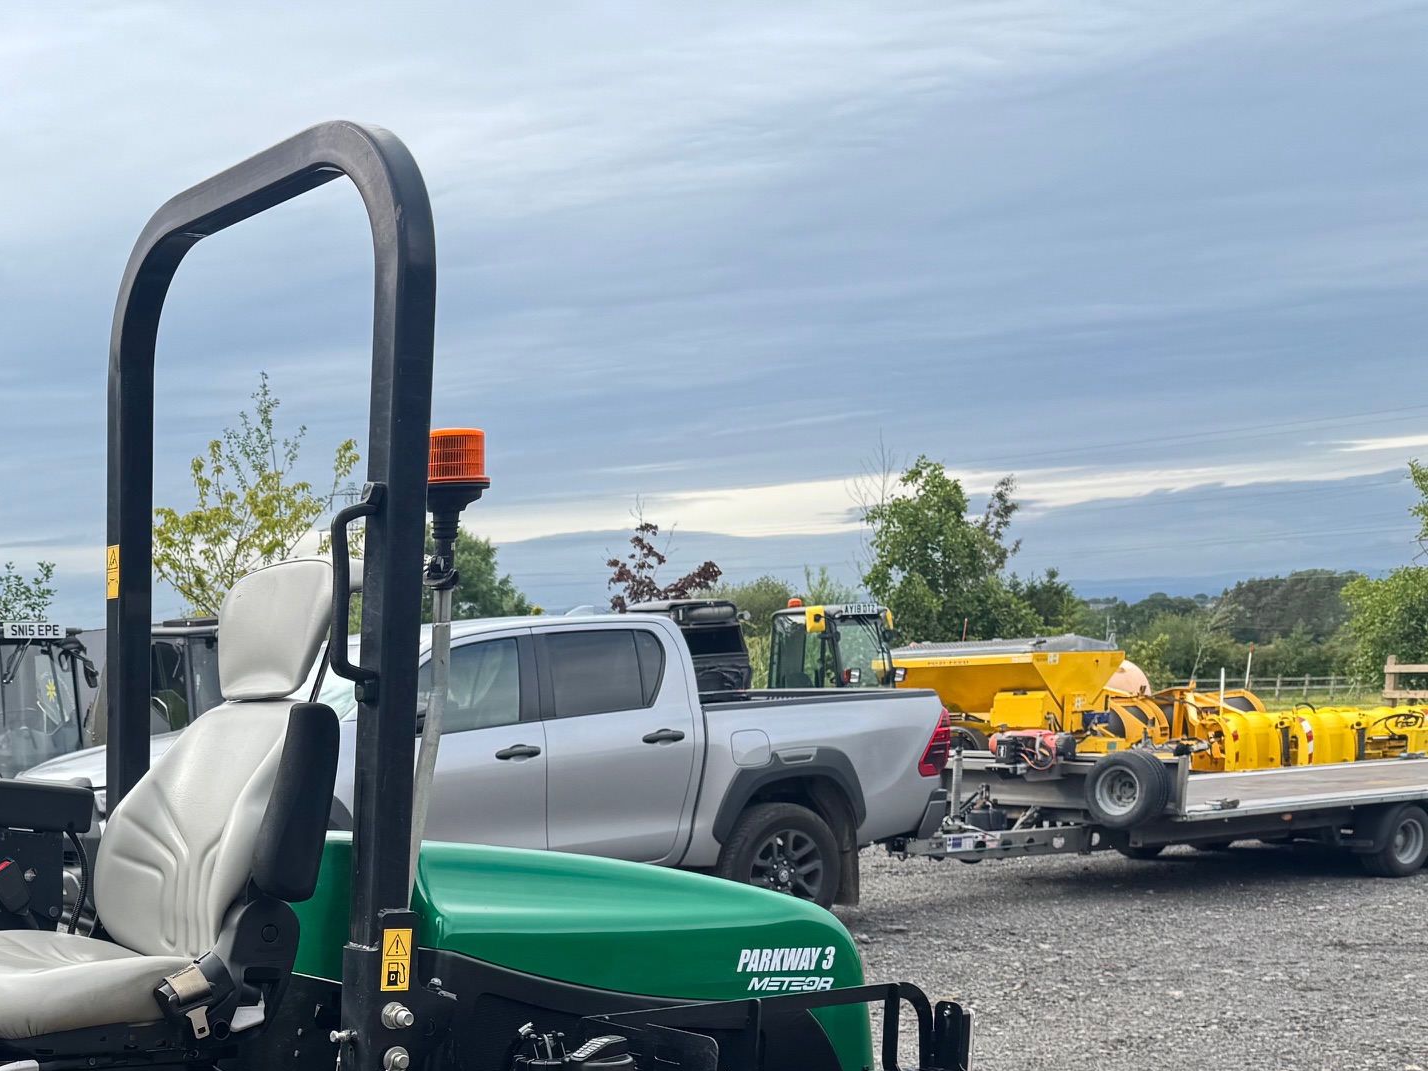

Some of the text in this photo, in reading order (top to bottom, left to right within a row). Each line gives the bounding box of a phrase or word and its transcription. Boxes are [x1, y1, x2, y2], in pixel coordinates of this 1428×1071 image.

[10, 624, 60, 637] SN15 EPE
[736, 946, 836, 973] PARKWAY 3
[390, 973, 396, 981] D
[747, 976, 834, 991] METEOR
